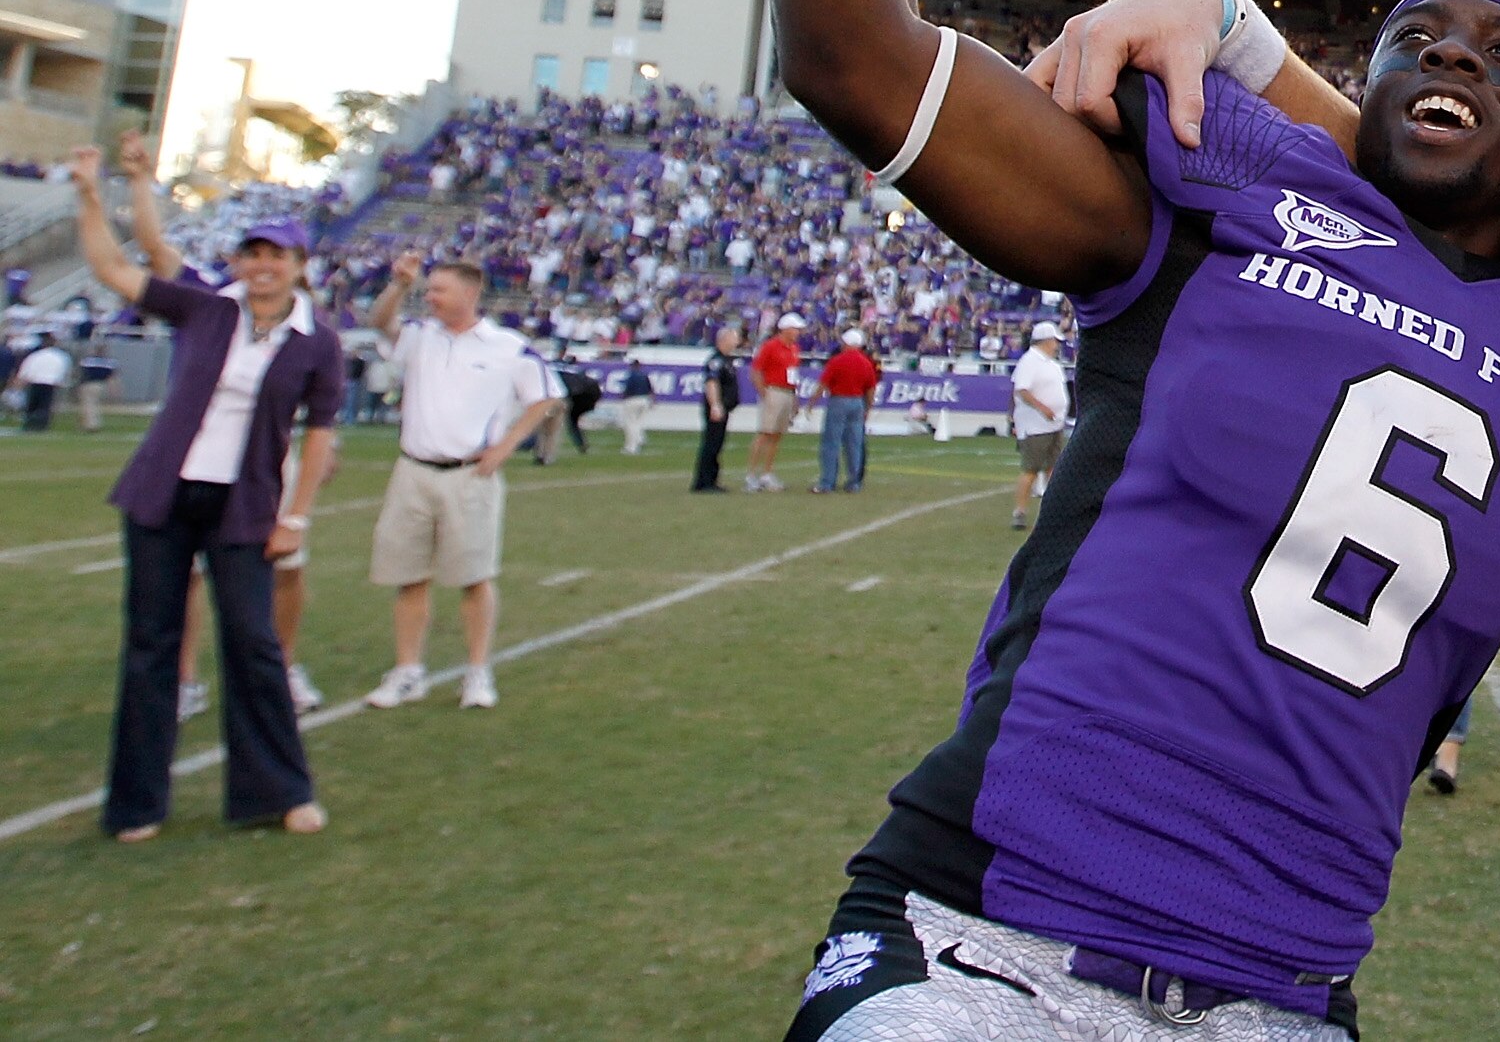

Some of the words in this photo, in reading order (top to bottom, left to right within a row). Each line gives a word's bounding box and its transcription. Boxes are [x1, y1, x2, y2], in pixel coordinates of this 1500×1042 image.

[1300, 207, 1348, 233] Mtn.
[1322, 226, 1351, 239] WEST
[1238, 252, 1466, 362] HORNED
[887, 378, 960, 403] Bank
[1243, 364, 1500, 698] 6
